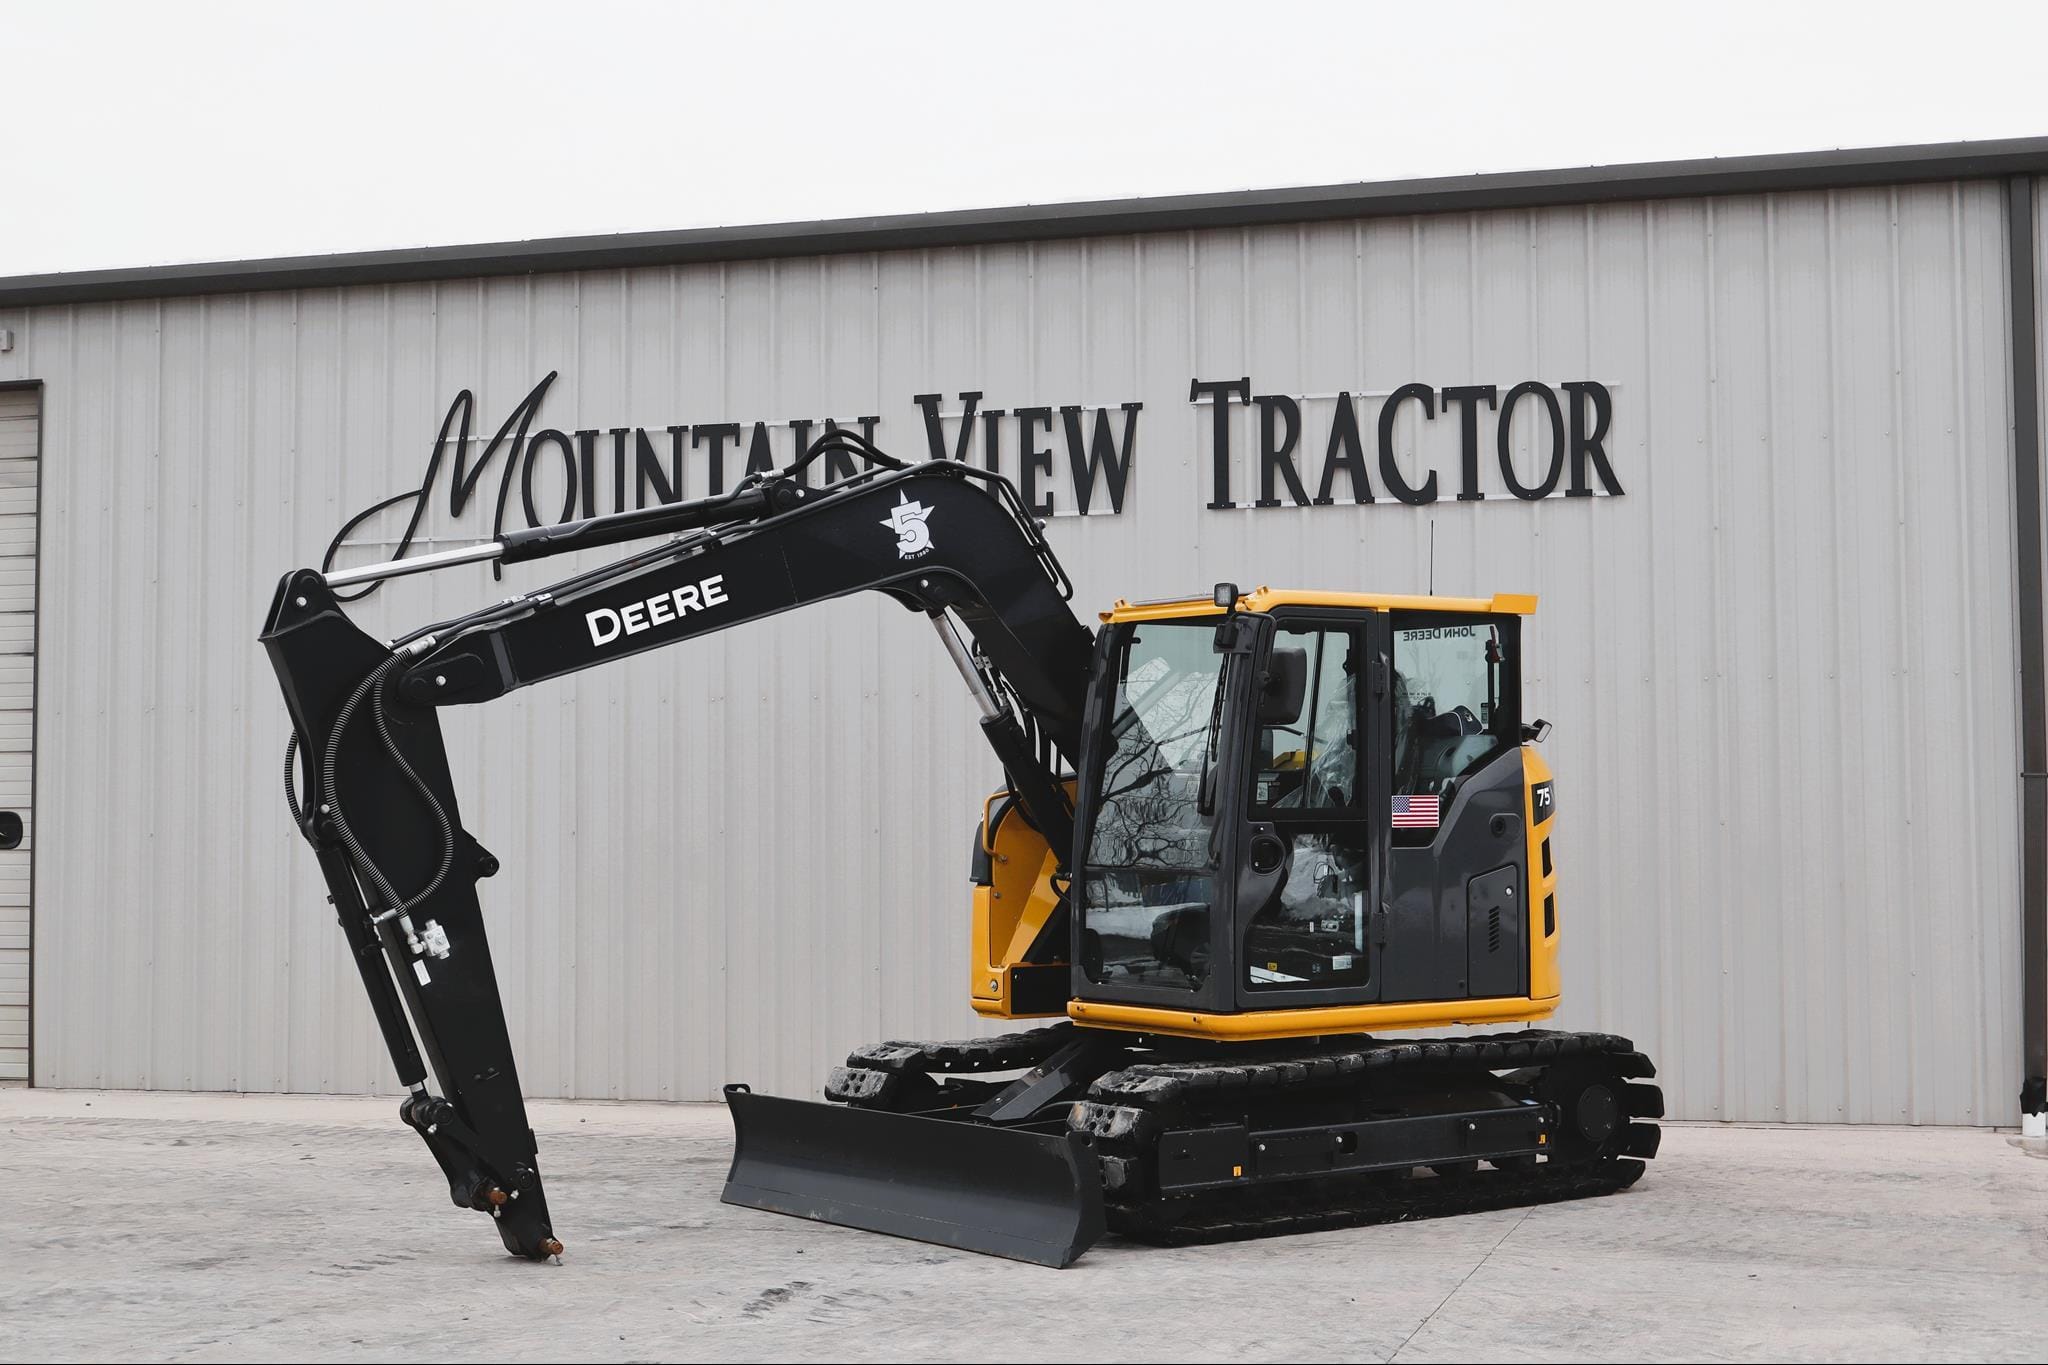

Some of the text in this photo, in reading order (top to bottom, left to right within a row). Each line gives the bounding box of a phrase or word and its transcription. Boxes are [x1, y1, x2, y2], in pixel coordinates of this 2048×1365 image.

[914, 391, 1143, 516] VIEW
[1190, 377, 1625, 509] TRACTOR
[585, 574, 729, 647] DEERE
[1536, 787, 1551, 807] 75
